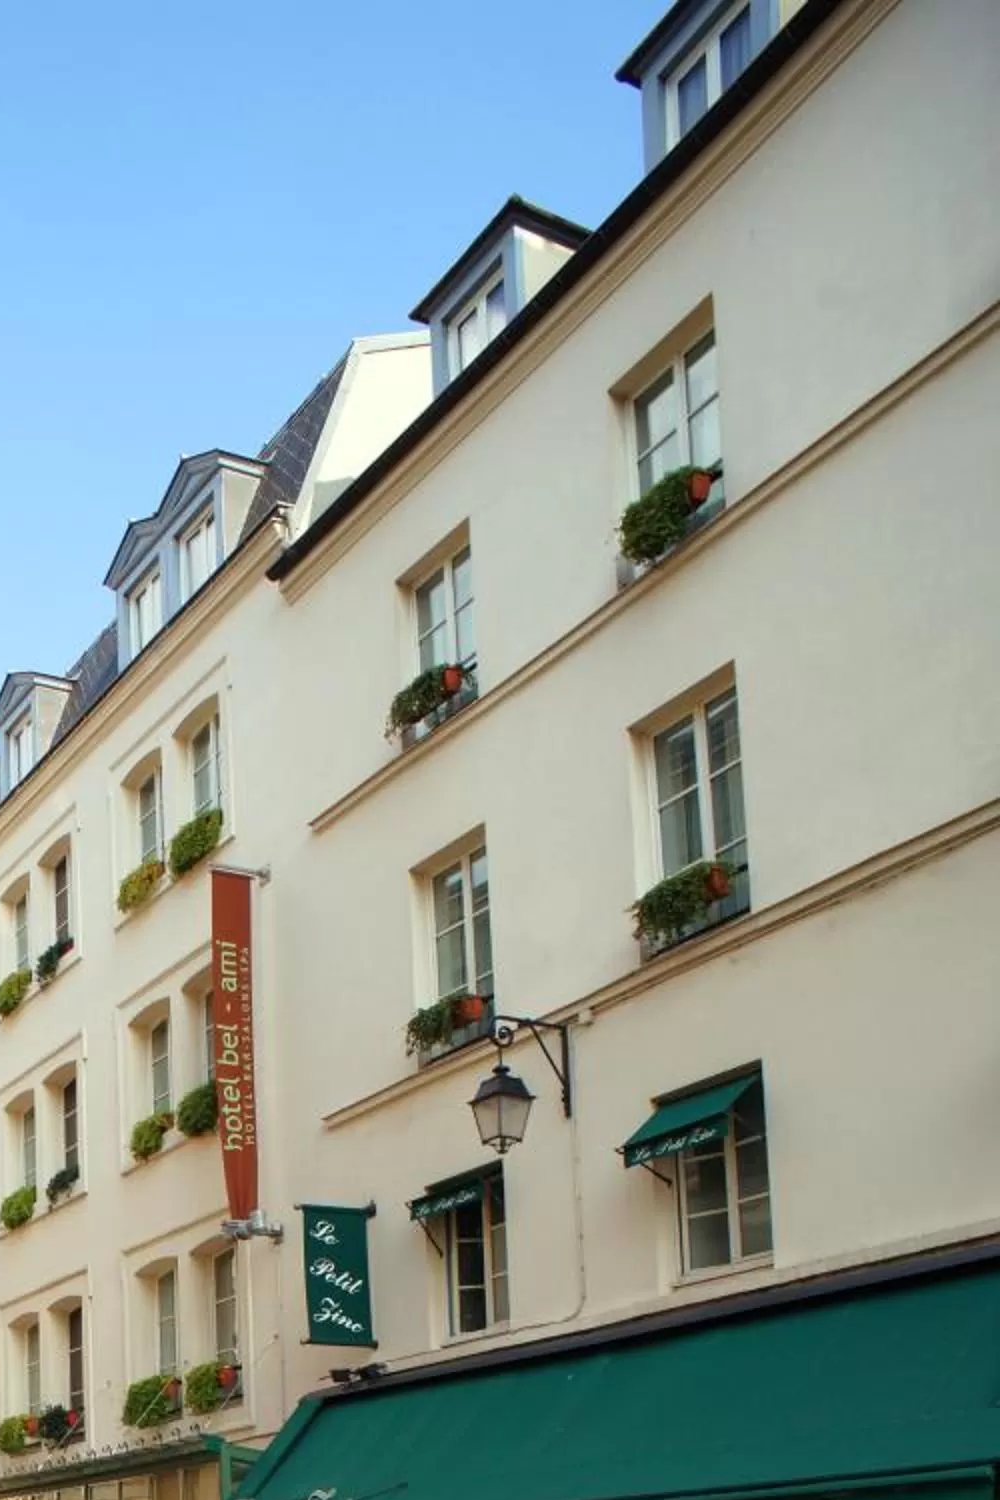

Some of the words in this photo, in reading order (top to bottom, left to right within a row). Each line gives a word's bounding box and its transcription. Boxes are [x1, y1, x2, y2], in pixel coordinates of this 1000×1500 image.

[215, 939, 237, 992] ami
[216, 1024, 239, 1066] bel
[217, 1077, 243, 1151] hotel
[309, 1220, 340, 1245] Le
[309, 1257, 364, 1295] Petit
[312, 1296, 365, 1333] Zinc
